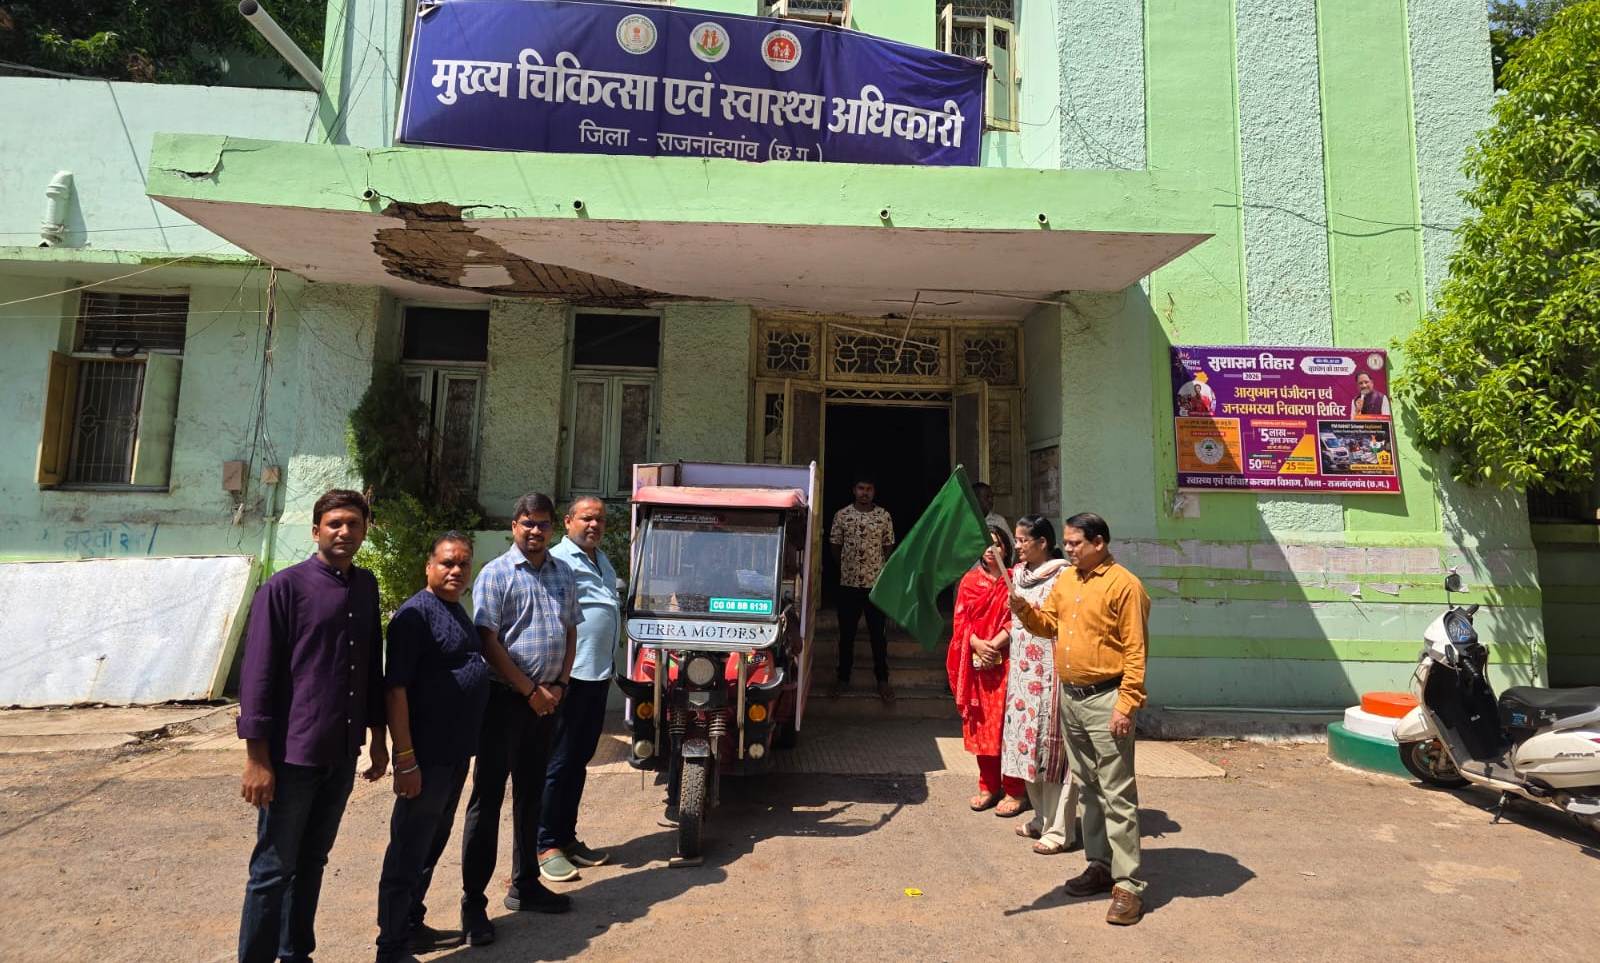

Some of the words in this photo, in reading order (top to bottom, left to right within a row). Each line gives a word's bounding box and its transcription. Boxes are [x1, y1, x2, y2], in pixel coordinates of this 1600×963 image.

[431, 59, 512, 105] मुख्य
[517, 48, 658, 112] चिकित्सा
[663, 71, 715, 117] एवं
[720, 83, 825, 130] स्वास्थ्य
[828, 84, 966, 148] अधिकारी
[578, 119, 630, 147] जिला
[656, 131, 760, 160] राजनांदगांव
[768, 138, 823, 162] (छग)
[1207, 356, 1257, 371] सुशासन
[1259, 353, 1295, 370] तिहार
[1234, 387, 1278, 401] आयुष्मान
[1281, 386, 1316, 399] पंजीयन
[1318, 386, 1333, 400] एवं
[1222, 403, 1274, 415] जनसमस्या
[1277, 402, 1314, 416] निवारण
[1317, 402, 1347, 416] शिविर
[1269, 429, 1286, 437] लाख
[1249, 459, 1262, 469] 50
[1286, 462, 1296, 470] 25
[1213, 476, 1224, 486] एवं
[1225, 476, 1248, 486] परिवार
[1249, 478, 1276, 486] कल्याण
[1304, 477, 1321, 487] जिला
[1328, 479, 1366, 489] राजनांदगांव
[713, 601, 724, 609] CG
[737, 602, 748, 610] BB
[638, 623, 687, 637] TERRA
[692, 625, 757, 640] MOTORS
